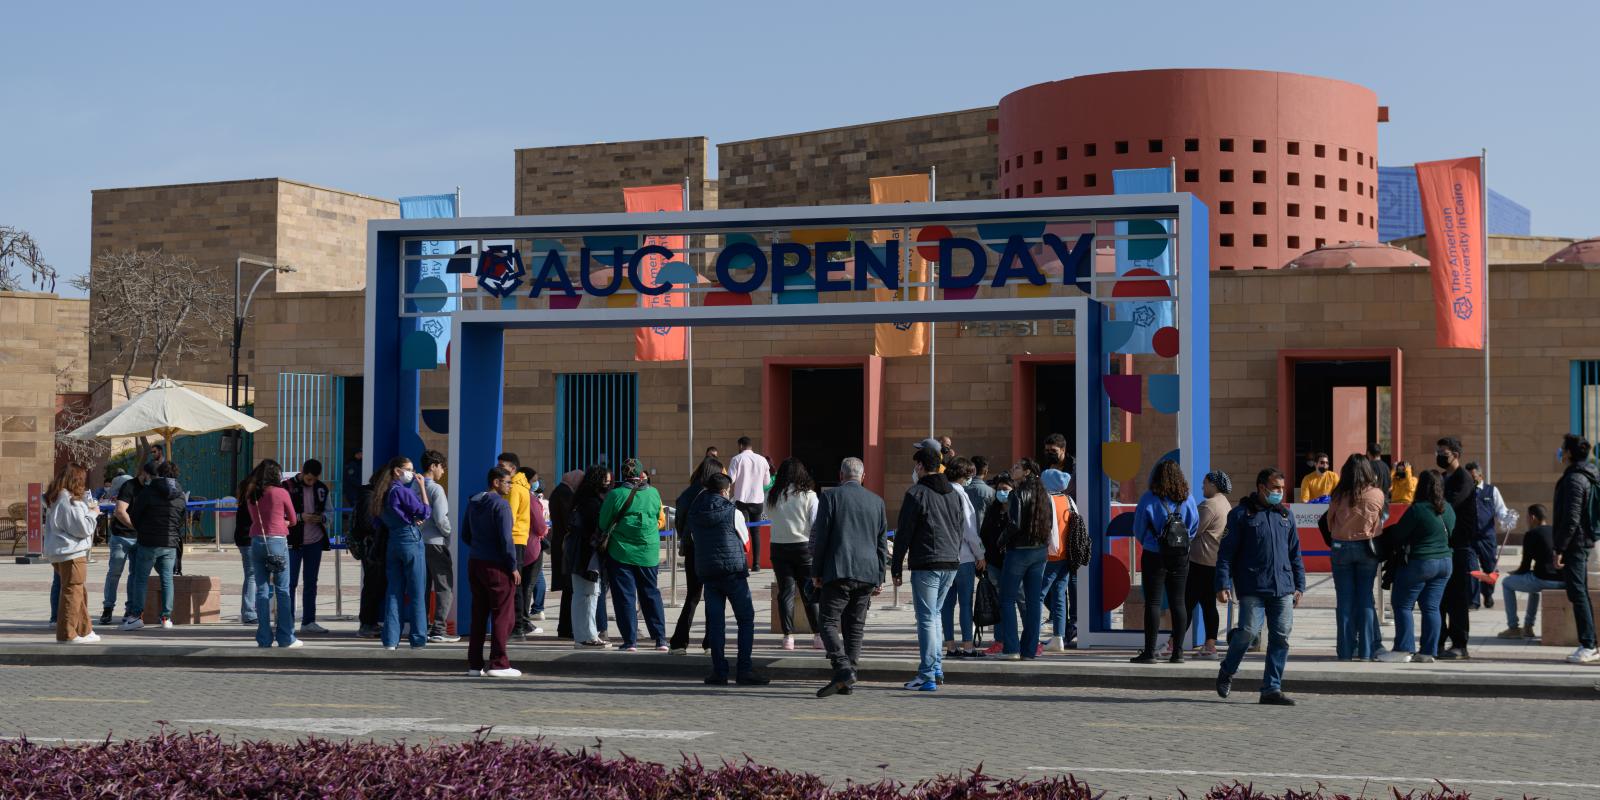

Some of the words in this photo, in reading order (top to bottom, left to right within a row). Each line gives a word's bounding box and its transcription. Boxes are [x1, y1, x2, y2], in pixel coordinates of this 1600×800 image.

[1454, 184, 1465, 215] Cairo
[1442, 207, 1458, 265] American
[1457, 217, 1466, 230] in
[528, 244, 675, 298] AUC
[715, 239, 899, 294] OPEN
[938, 233, 1095, 289] DAY
[1460, 231, 1472, 294] University
[1451, 269, 1461, 293] The
[1053, 319, 1077, 336] E
